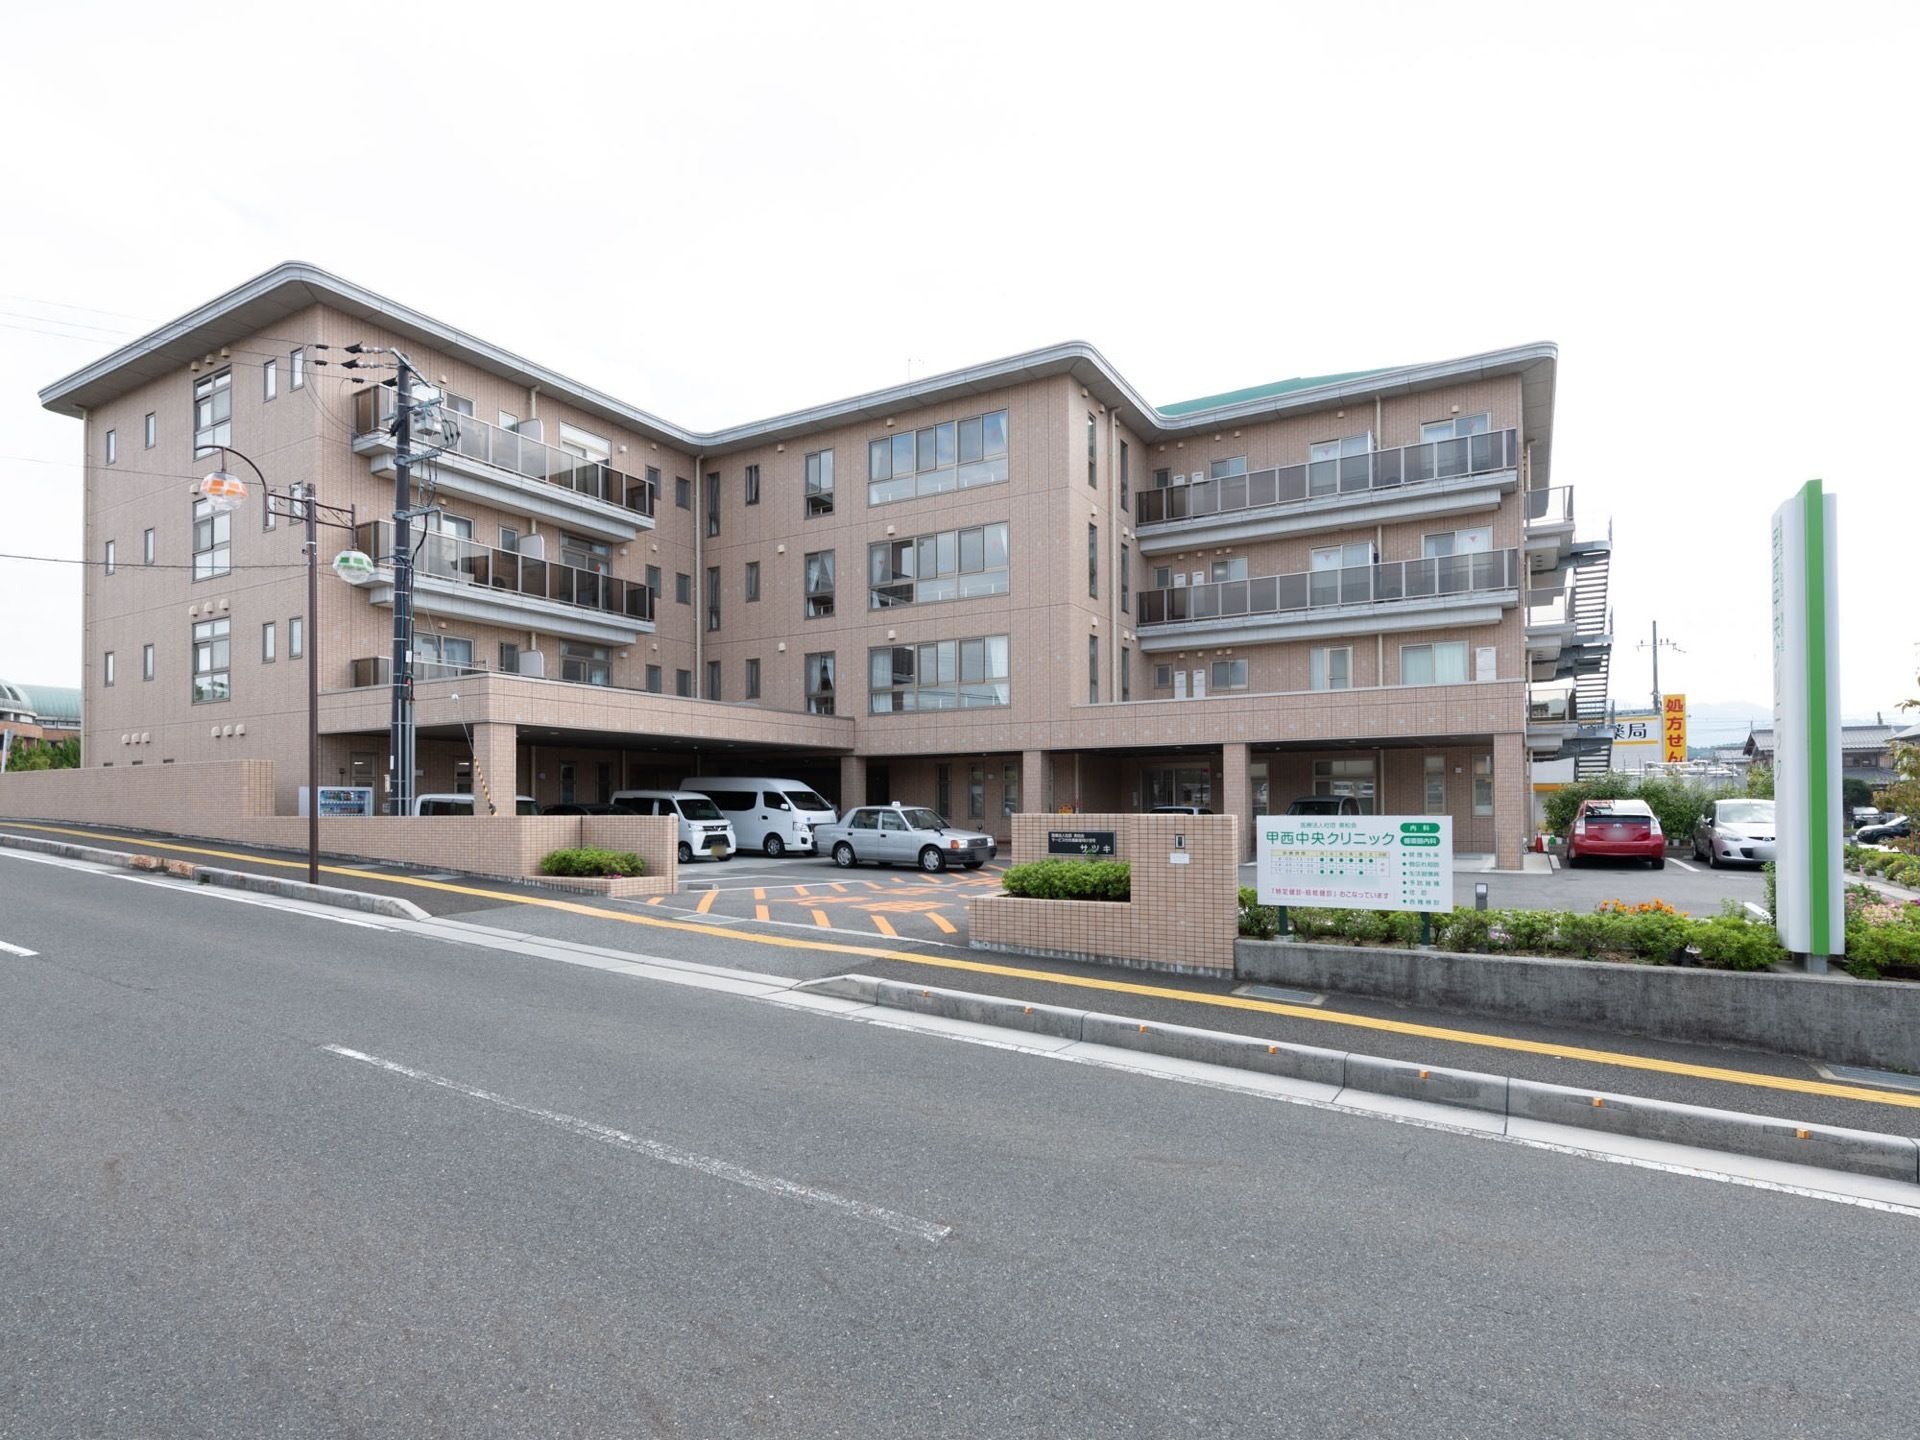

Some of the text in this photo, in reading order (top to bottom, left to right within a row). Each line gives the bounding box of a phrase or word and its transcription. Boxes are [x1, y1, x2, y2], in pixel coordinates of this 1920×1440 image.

[1665, 698, 1684, 763] 処方せん
[1409, 824, 1430, 832] 内科
[1266, 831, 1395, 846] 甲西中央クリニック
[1080, 843, 1111, 855] サツキ
